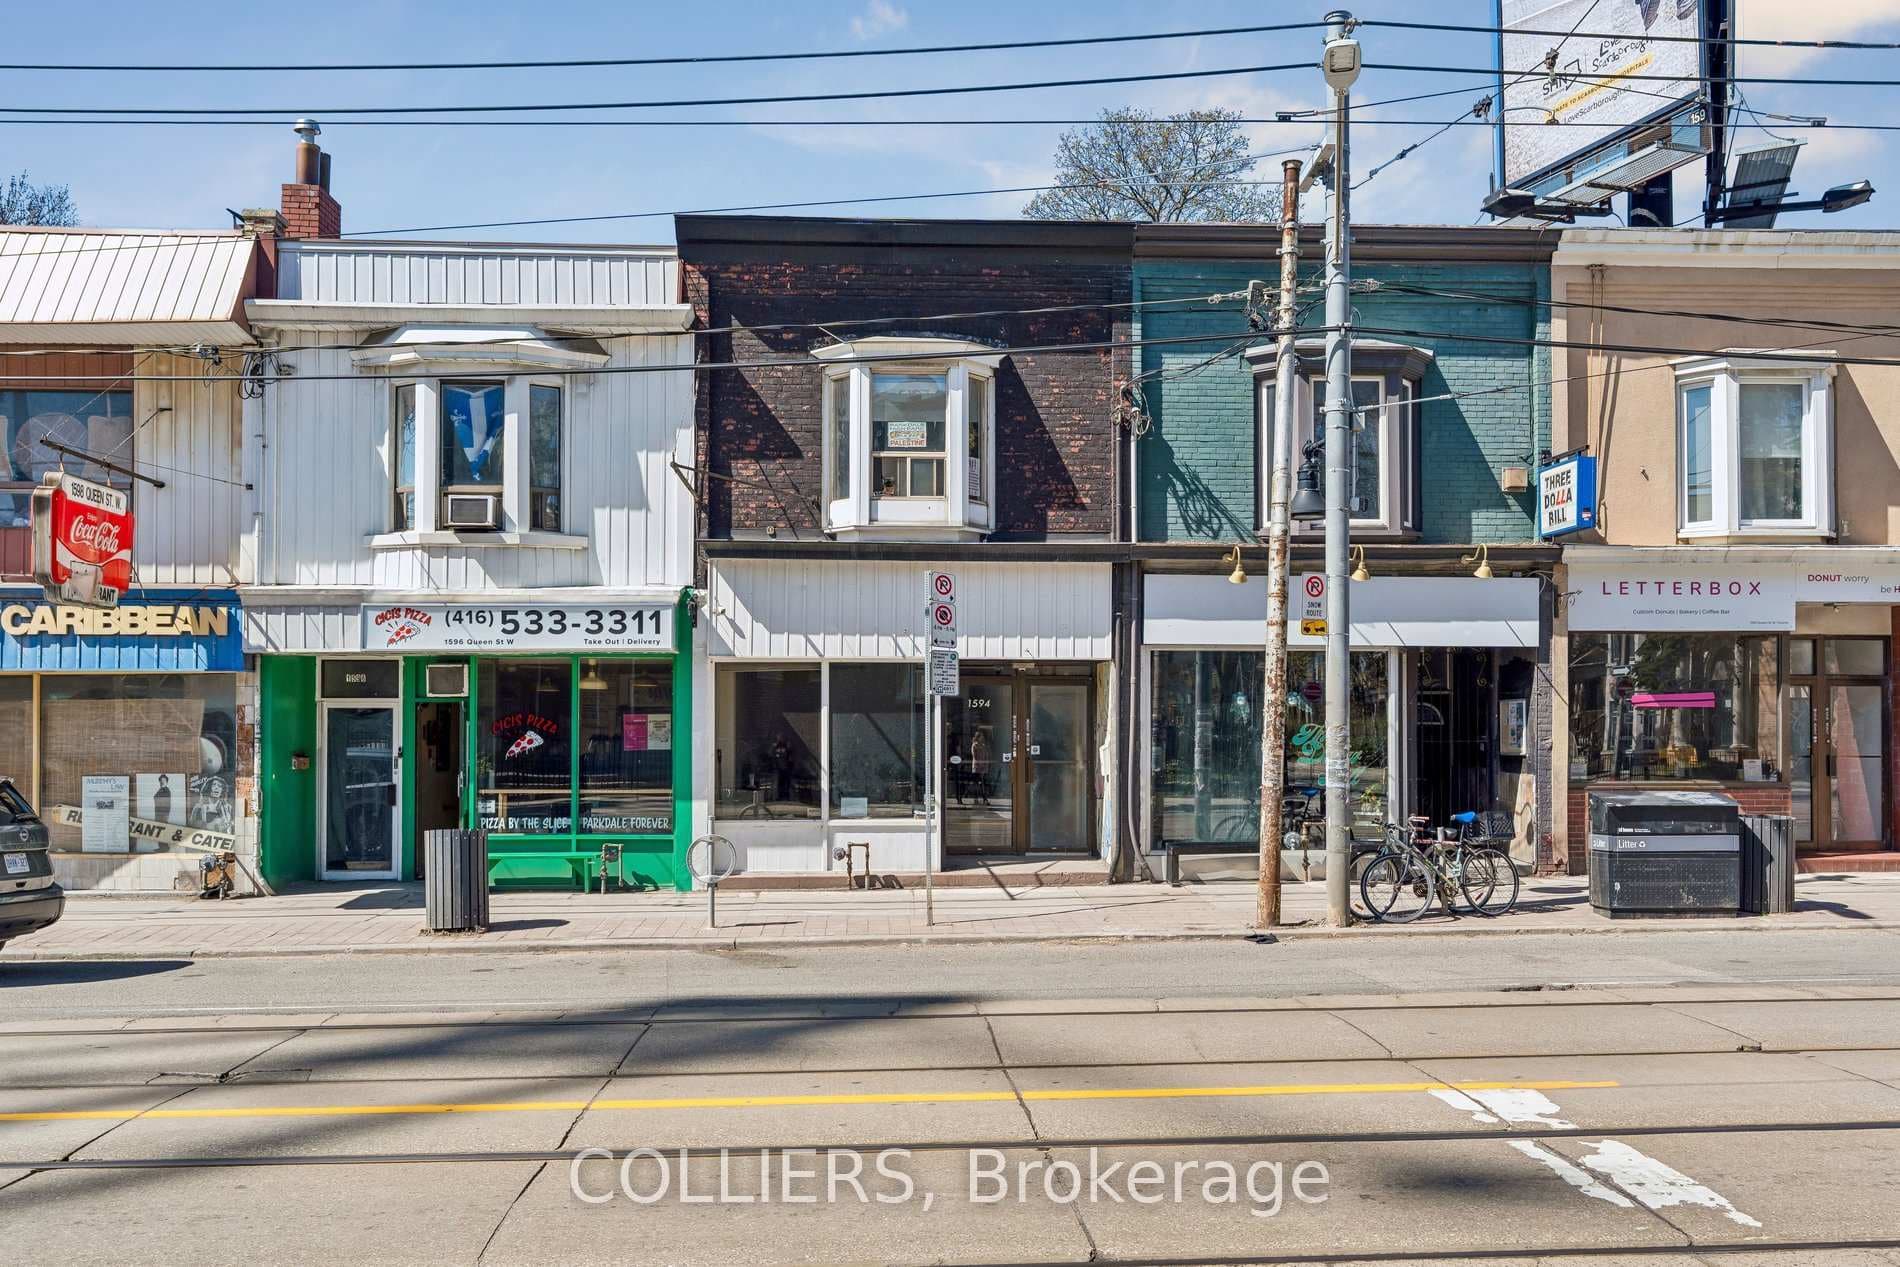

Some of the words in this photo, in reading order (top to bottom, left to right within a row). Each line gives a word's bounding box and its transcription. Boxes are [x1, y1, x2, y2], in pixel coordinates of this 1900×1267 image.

[1600, 37, 1621, 57] Love
[1690, 109, 1706, 124] 159
[1544, 469, 1571, 490] THREE
[71, 483, 84, 499] 1598
[85, 487, 104, 503] QUEEN
[105, 494, 114, 506] ST.
[1544, 488, 1572, 509] DOLLA
[1548, 508, 1567, 526] BILL
[1807, 574, 1841, 582] DONUT
[1602, 581, 1761, 596] LETTERBOX
[1880, 585, 1891, 593] be
[1307, 601, 1321, 609] SNOW
[1, 604, 228, 636] CARIBBEAN
[404, 607, 432, 626] PIZZA
[1306, 609, 1322, 617] ROUTE
[445, 610, 494, 627] (416)
[501, 609, 660, 635] 533-3311
[467, 638, 493, 646] Queen
[627, 638, 661, 646] Delivery
[967, 699, 991, 708] 1594
[527, 713, 559, 735] PIZZA
[480, 817, 506, 830] PIZZA
[508, 816, 519, 829] BY
[522, 816, 540, 829] THE
[543, 816, 568, 829] SLICE
[582, 816, 628, 830] PARKDALE
[630, 816, 669, 829] FOREVER
[171, 828, 183, 842] &
[191, 833, 235, 851] CATE
[1618, 839, 1637, 849] Litter
